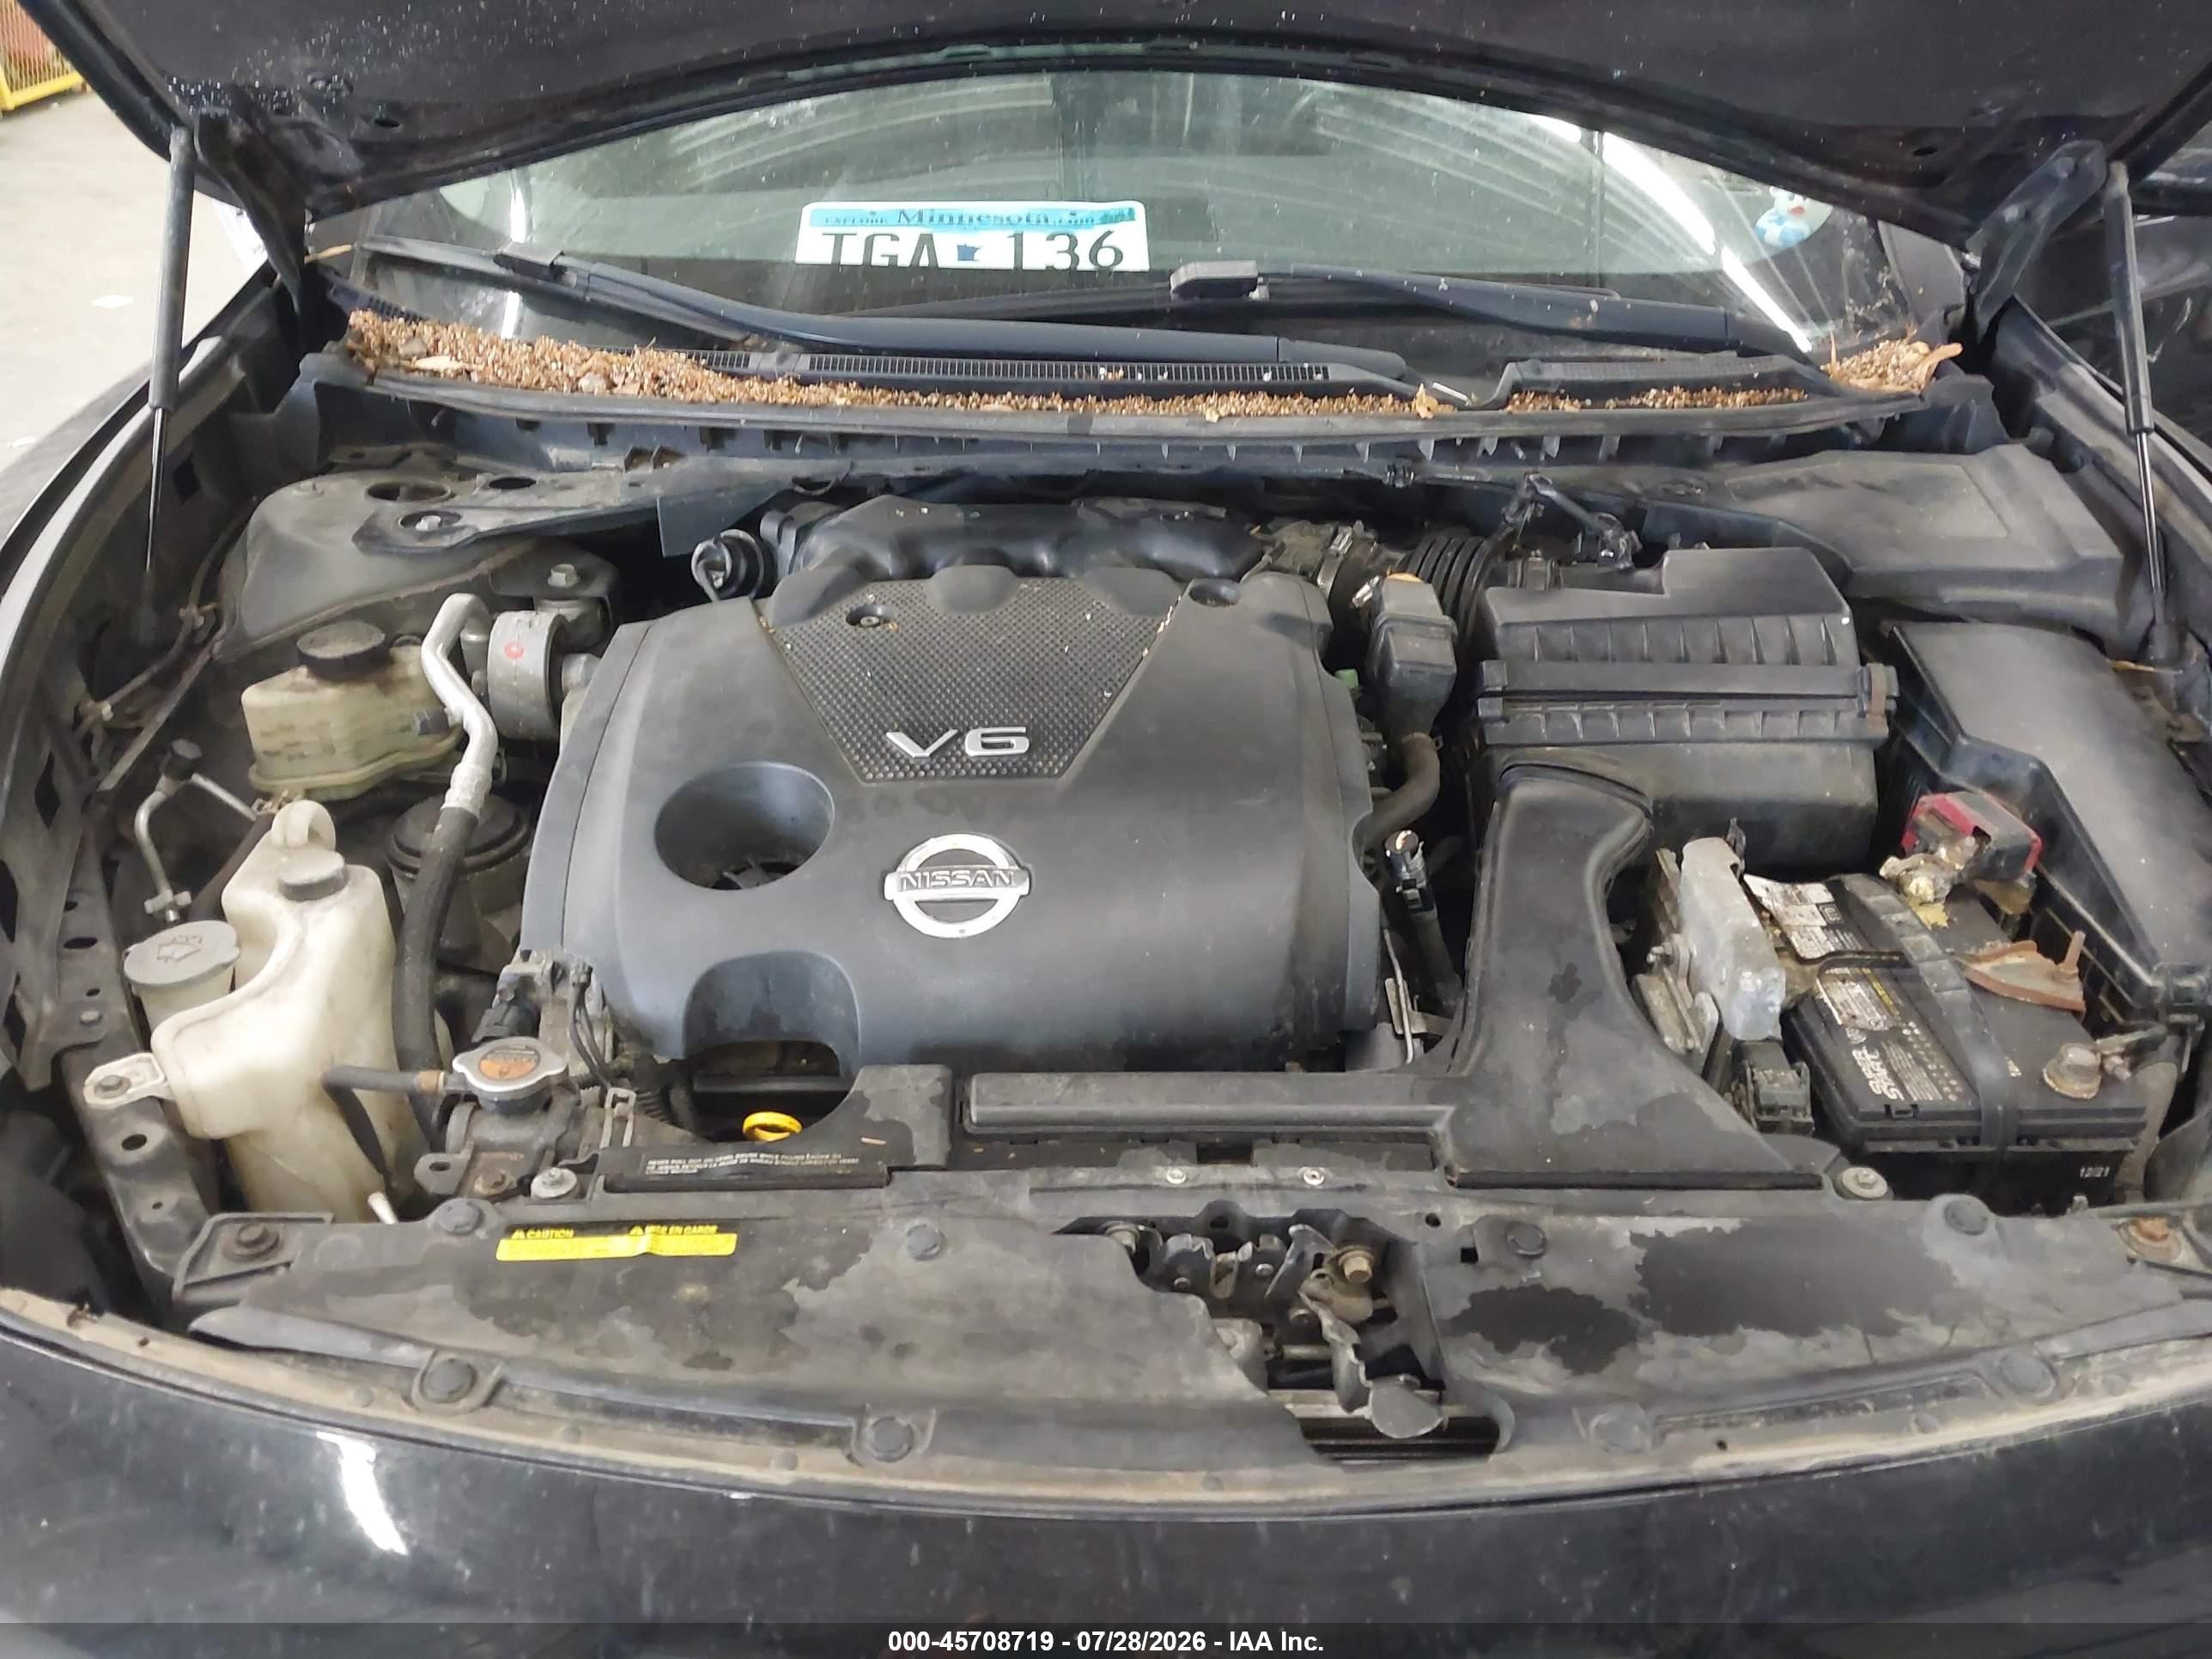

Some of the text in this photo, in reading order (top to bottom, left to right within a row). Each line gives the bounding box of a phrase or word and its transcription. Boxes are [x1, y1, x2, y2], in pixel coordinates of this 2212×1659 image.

[822, 230, 1123, 270] TGA 136
[885, 726, 1030, 757] V6
[902, 869, 1014, 890] NISSAN
[526, 1229, 574, 1238] CAUTION
